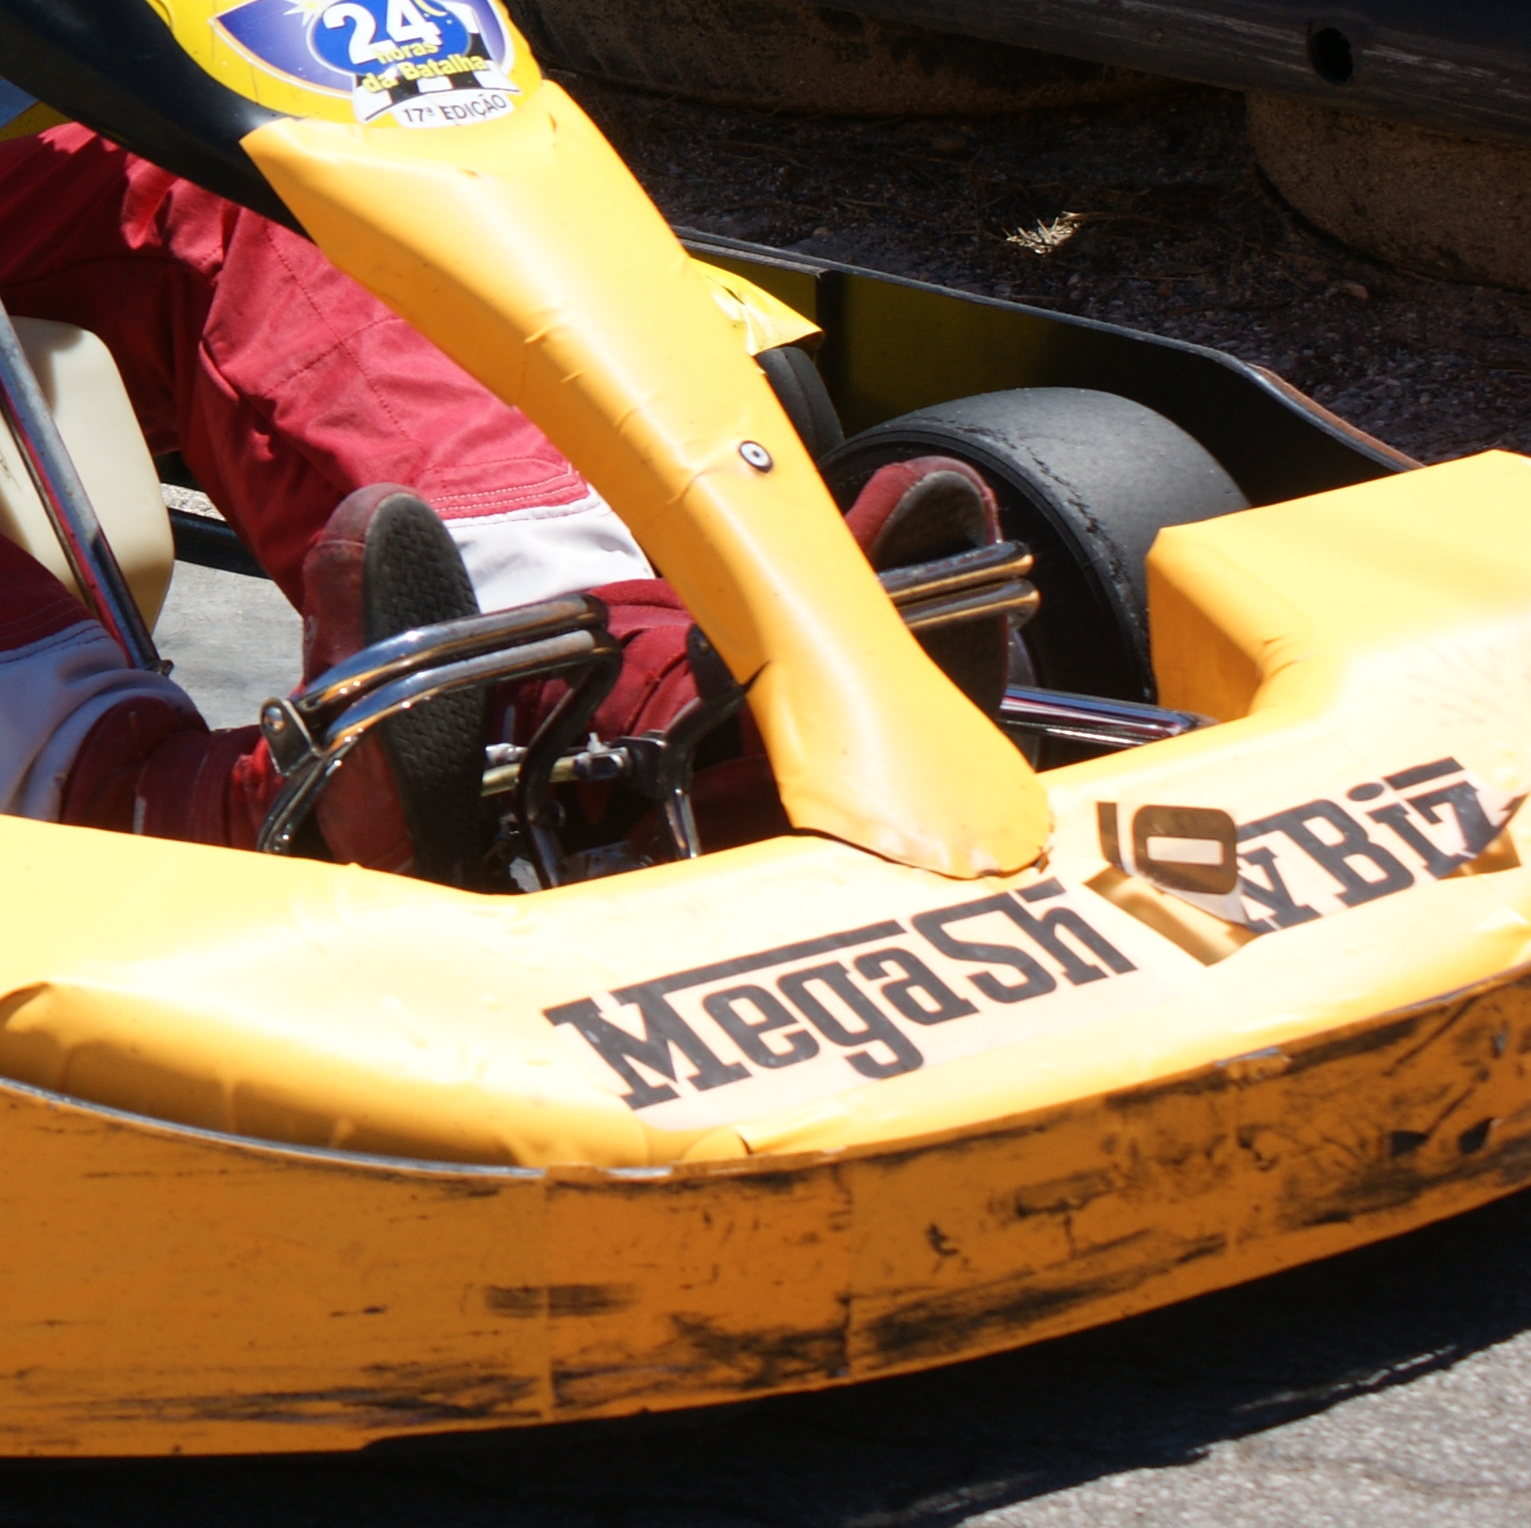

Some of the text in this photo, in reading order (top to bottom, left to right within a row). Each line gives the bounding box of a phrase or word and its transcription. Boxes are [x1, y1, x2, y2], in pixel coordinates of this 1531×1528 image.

[362, 54, 488, 93] da Batalha
[438, 93, 508, 122] EDIÇÃO
